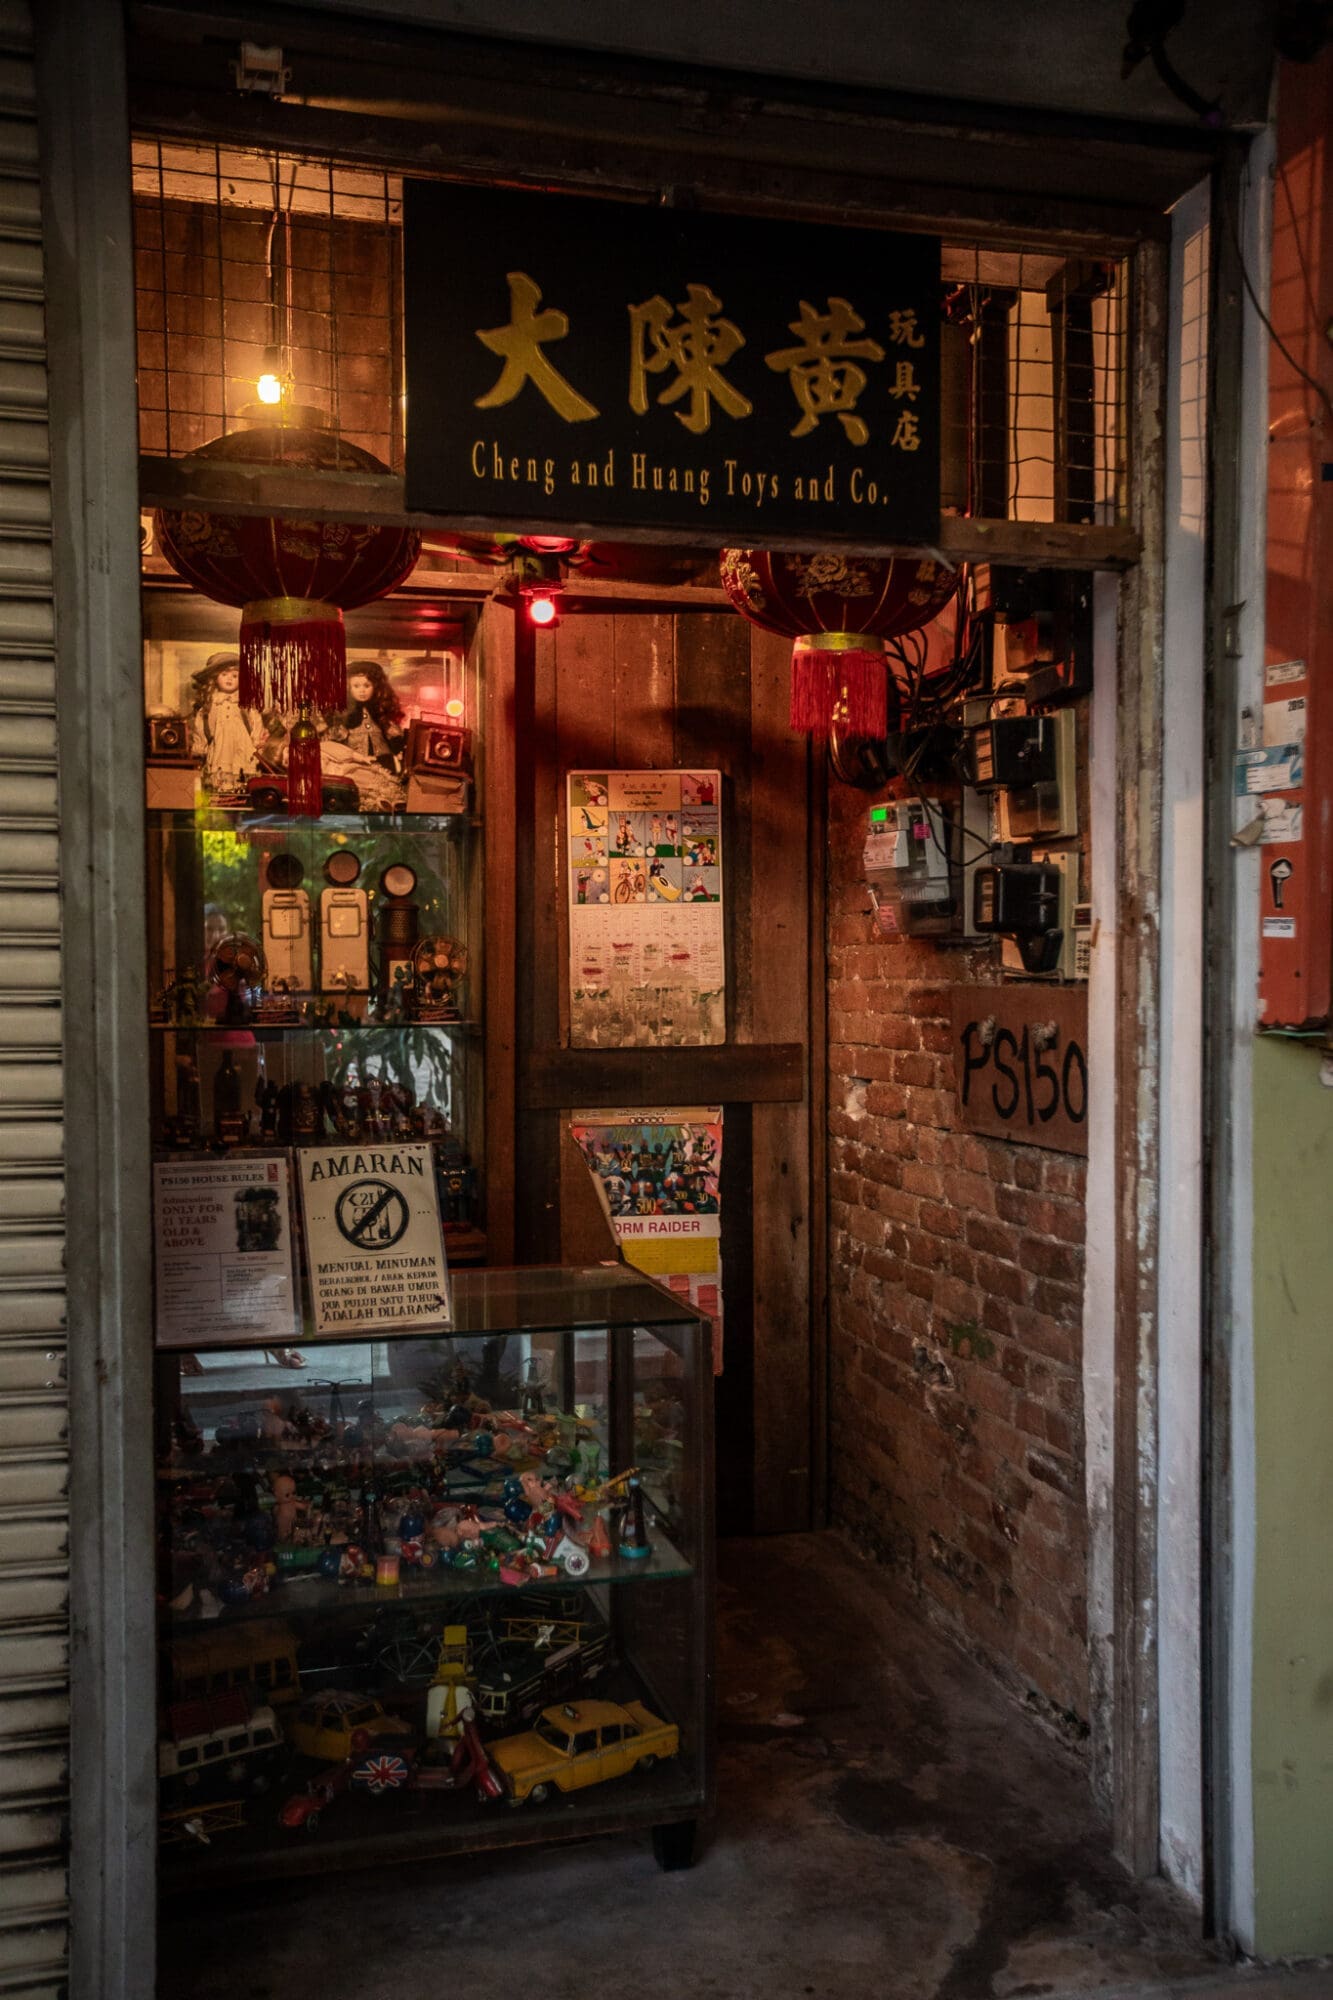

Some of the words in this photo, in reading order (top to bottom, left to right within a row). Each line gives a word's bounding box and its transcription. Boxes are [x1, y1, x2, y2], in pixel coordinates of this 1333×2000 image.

[887, 307, 927, 453] 玩具店
[470, 439, 557, 497] Cheng
[571, 448, 616, 488] and
[631, 452, 712, 506] Huang
[724, 458, 780, 508] Toys
[794, 465, 836, 504] and
[850, 467, 889, 506] Co.
[961, 1020, 1089, 1126] PS150
[309, 1153, 424, 1182] AMARAN
[160, 1176, 190, 1186] PS150
[191, 1175, 229, 1184] HOUSE
[231, 1173, 265, 1182] RULES
[162, 1205, 196, 1215] ONLY
[198, 1204, 224, 1213] FOR
[178, 1215, 217, 1225] YEARS
[648, 1221, 701, 1232] RAIDER
[162, 1227, 189, 1237] OLD
[163, 1238, 206, 1248] ABOVE
[317, 1260, 373, 1274] MENJUAL
[376, 1256, 436, 1270] MINUMAN
[381, 1273, 404, 1281] ARAK
[407, 1271, 438, 1280] KEPADA
[319, 1287, 354, 1298] ORANG
[357, 1286, 367, 1295] DI
[371, 1283, 404, 1294] BAWAH
[408, 1281, 439, 1290] UMUR
[321, 1300, 340, 1310] DUA
[344, 1298, 377, 1308] PULUH
[380, 1295, 404, 1305] SATU
[323, 1308, 374, 1322] ADALAH
[378, 1303, 440, 1318] DILARANG
